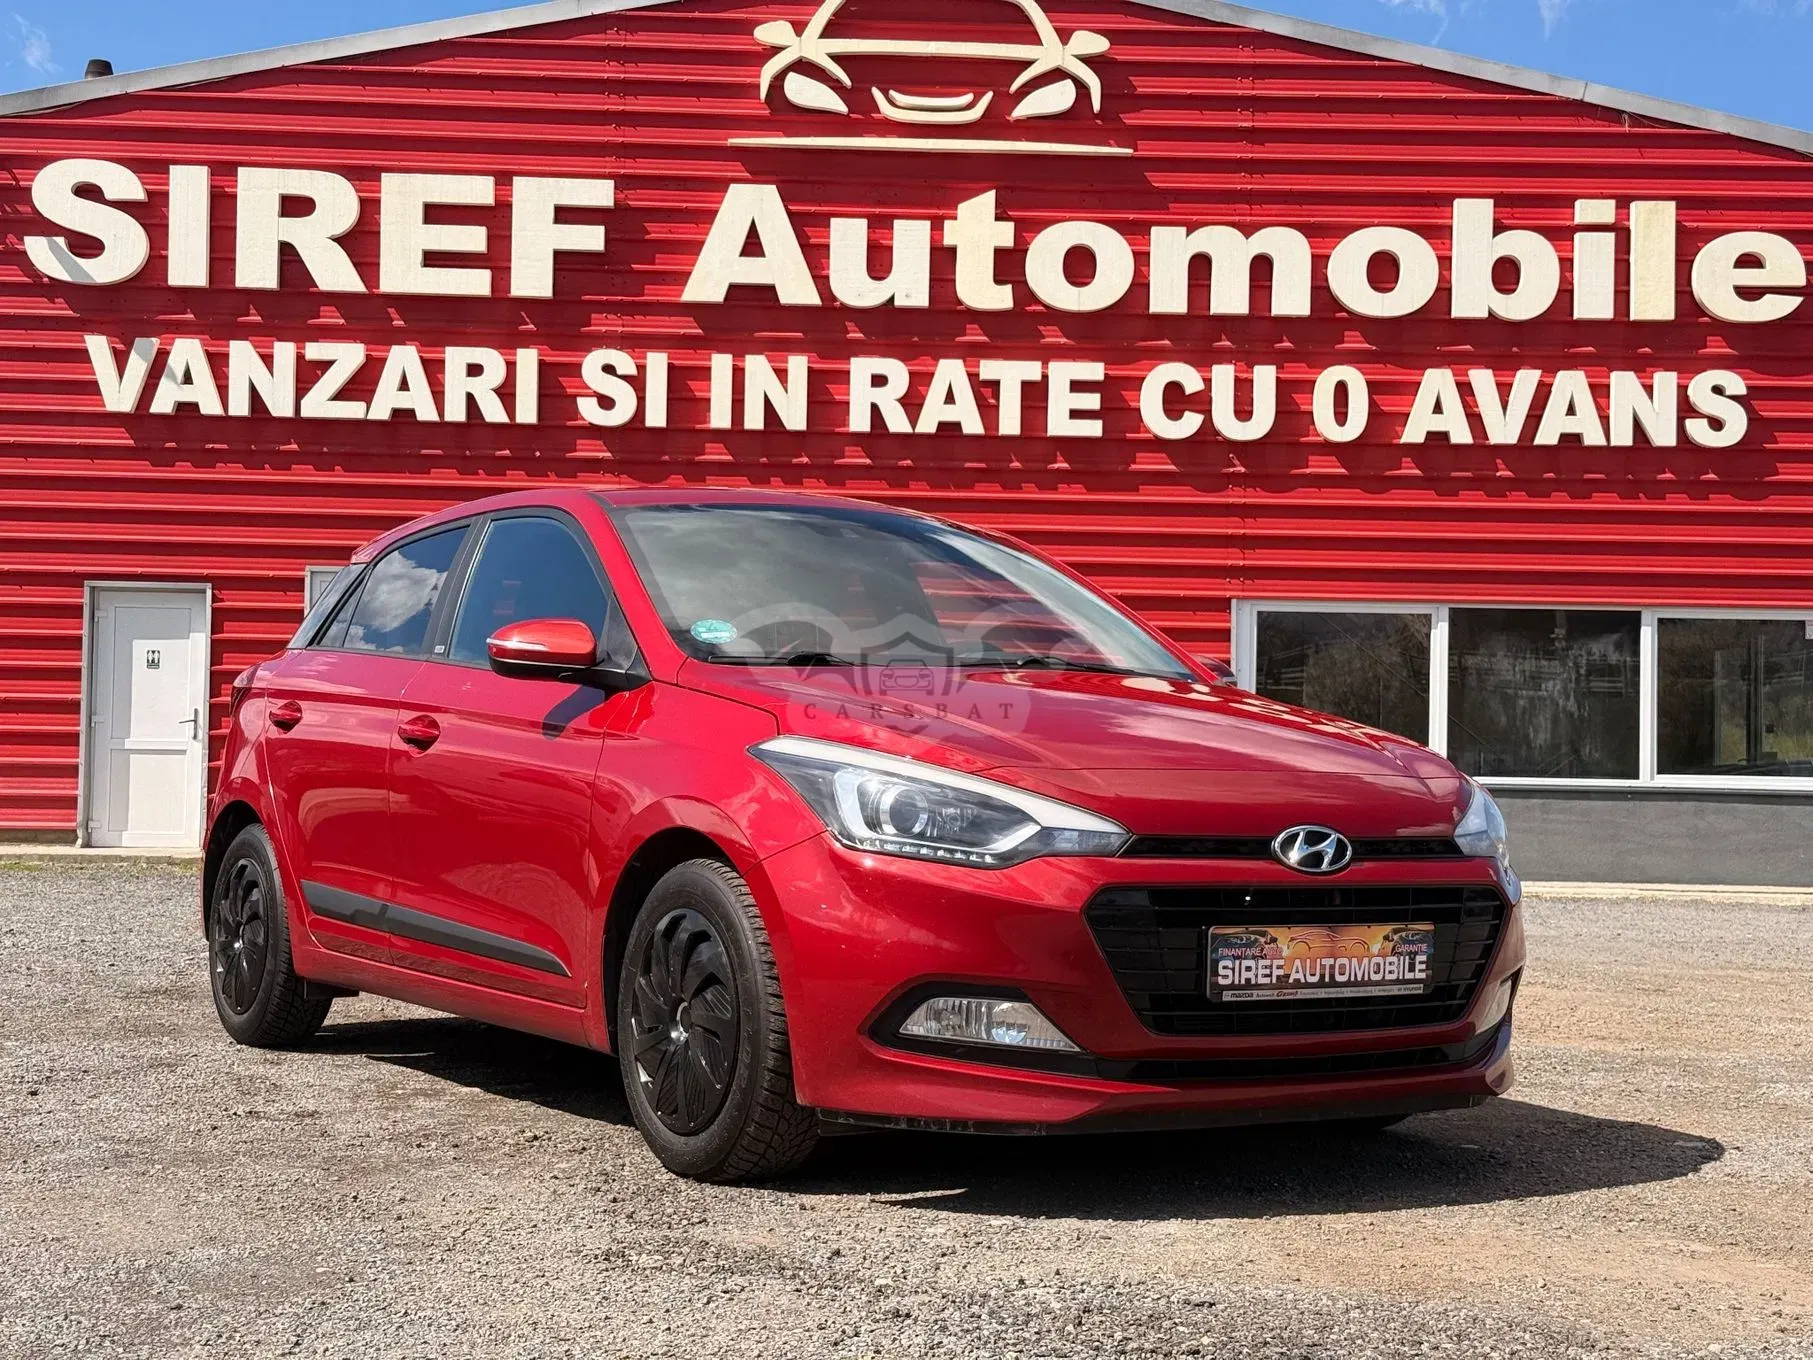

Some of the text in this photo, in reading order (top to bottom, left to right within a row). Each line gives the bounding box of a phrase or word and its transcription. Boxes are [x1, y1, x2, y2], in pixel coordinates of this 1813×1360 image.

[23, 157, 1807, 323] SIREF Automobile
[83, 334, 541, 424] VANZARI
[576, 347, 669, 428] SI
[709, 353, 810, 431] IN
[848, 356, 1106, 438] RATE
[1140, 361, 1278, 441] CU
[1399, 367, 1748, 448] AVANS
[1217, 955, 1427, 985] SIREF AUTOMOBILE
